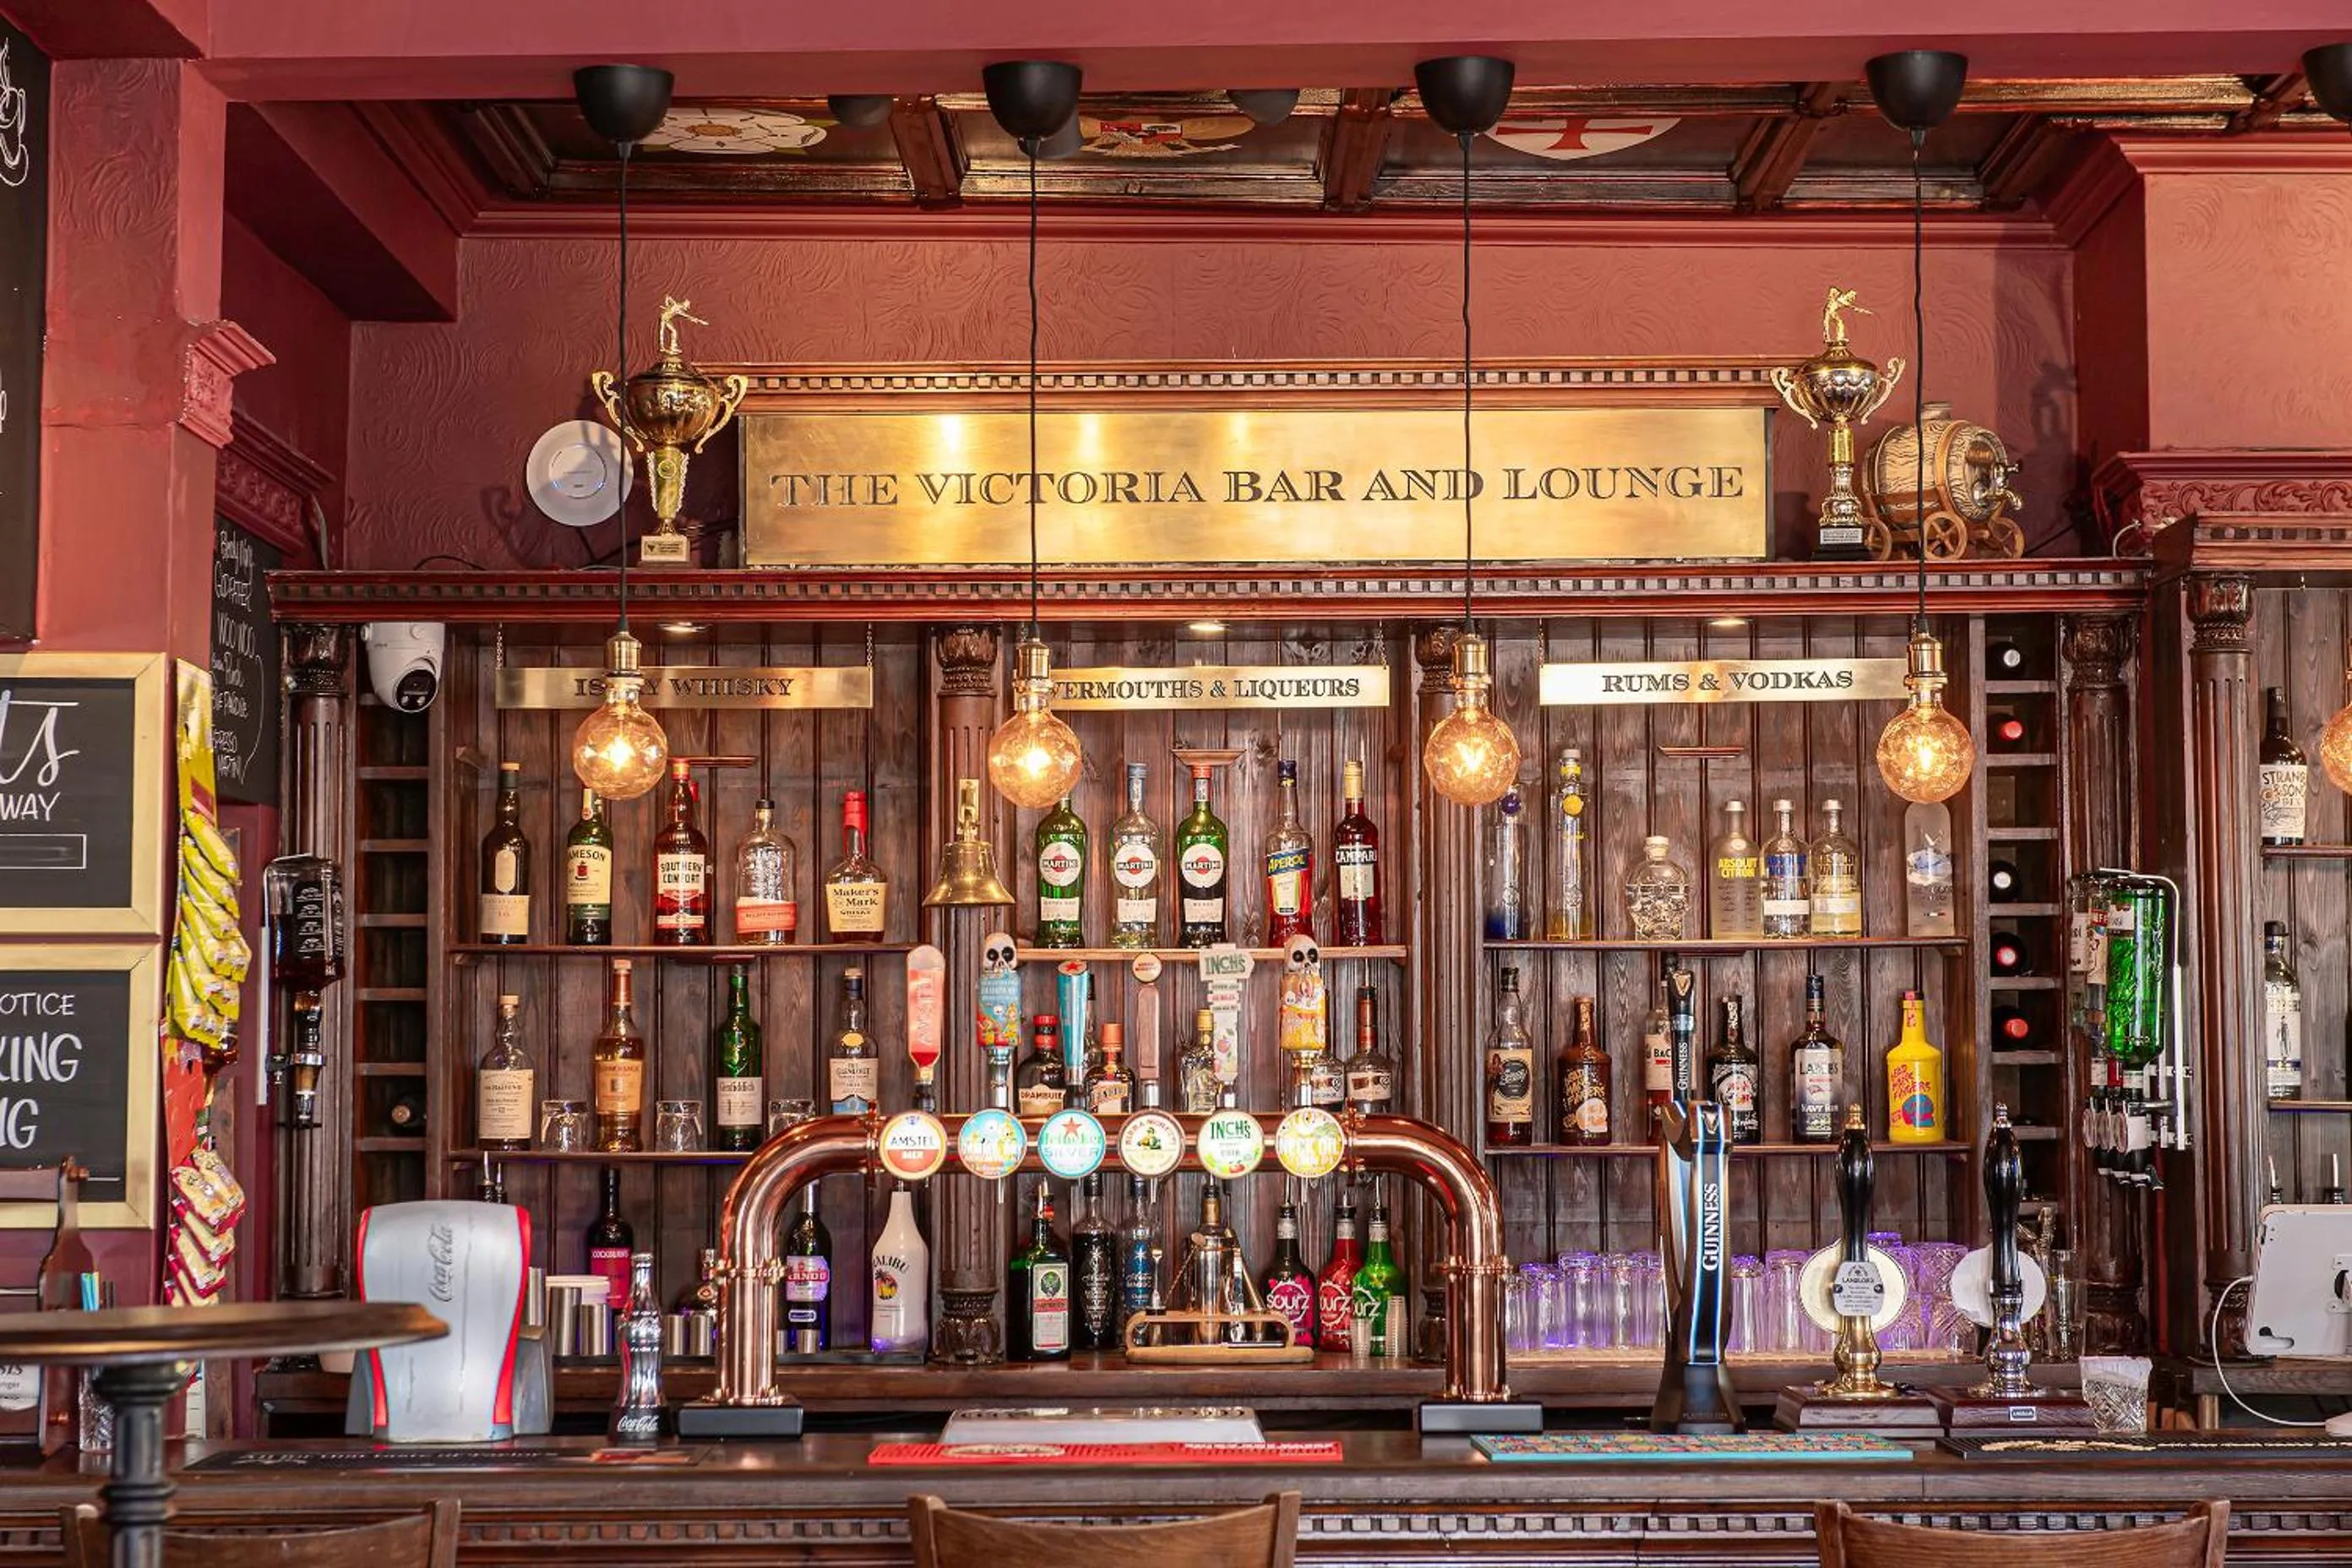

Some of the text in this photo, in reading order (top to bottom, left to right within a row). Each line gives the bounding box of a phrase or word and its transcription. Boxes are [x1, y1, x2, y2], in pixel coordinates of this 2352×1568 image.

[770, 466, 1745, 506] THE VICTORIA BAR AND LOUNGE
[1602, 670, 1854, 693] RUMS & VODKAS
[574, 678, 795, 697] ISY WHISKY
[1052, 678, 1360, 700] VERMOUTHS & LIQUEURS
[1336, 849, 1376, 863] CAMPARI
[662, 862, 703, 873] SOUTHERN
[1043, 859, 1078, 868] MARTINI
[1116, 861, 1153, 870] MARTINI
[1185, 861, 1221, 871] MARTINI
[1268, 854, 1305, 873] APEROL
[1718, 858, 1757, 868] ABSOLUT
[662, 874, 700, 884] COMFORT
[1721, 868, 1756, 879] CITRON
[846, 897, 878, 906] Mark
[1653, 1048, 1671, 1057] BAC
[1677, 1042, 1688, 1091] GUINNESS
[890, 1135, 934, 1146] AMSTEL
[1702, 1182, 1719, 1271] GUINNESS
